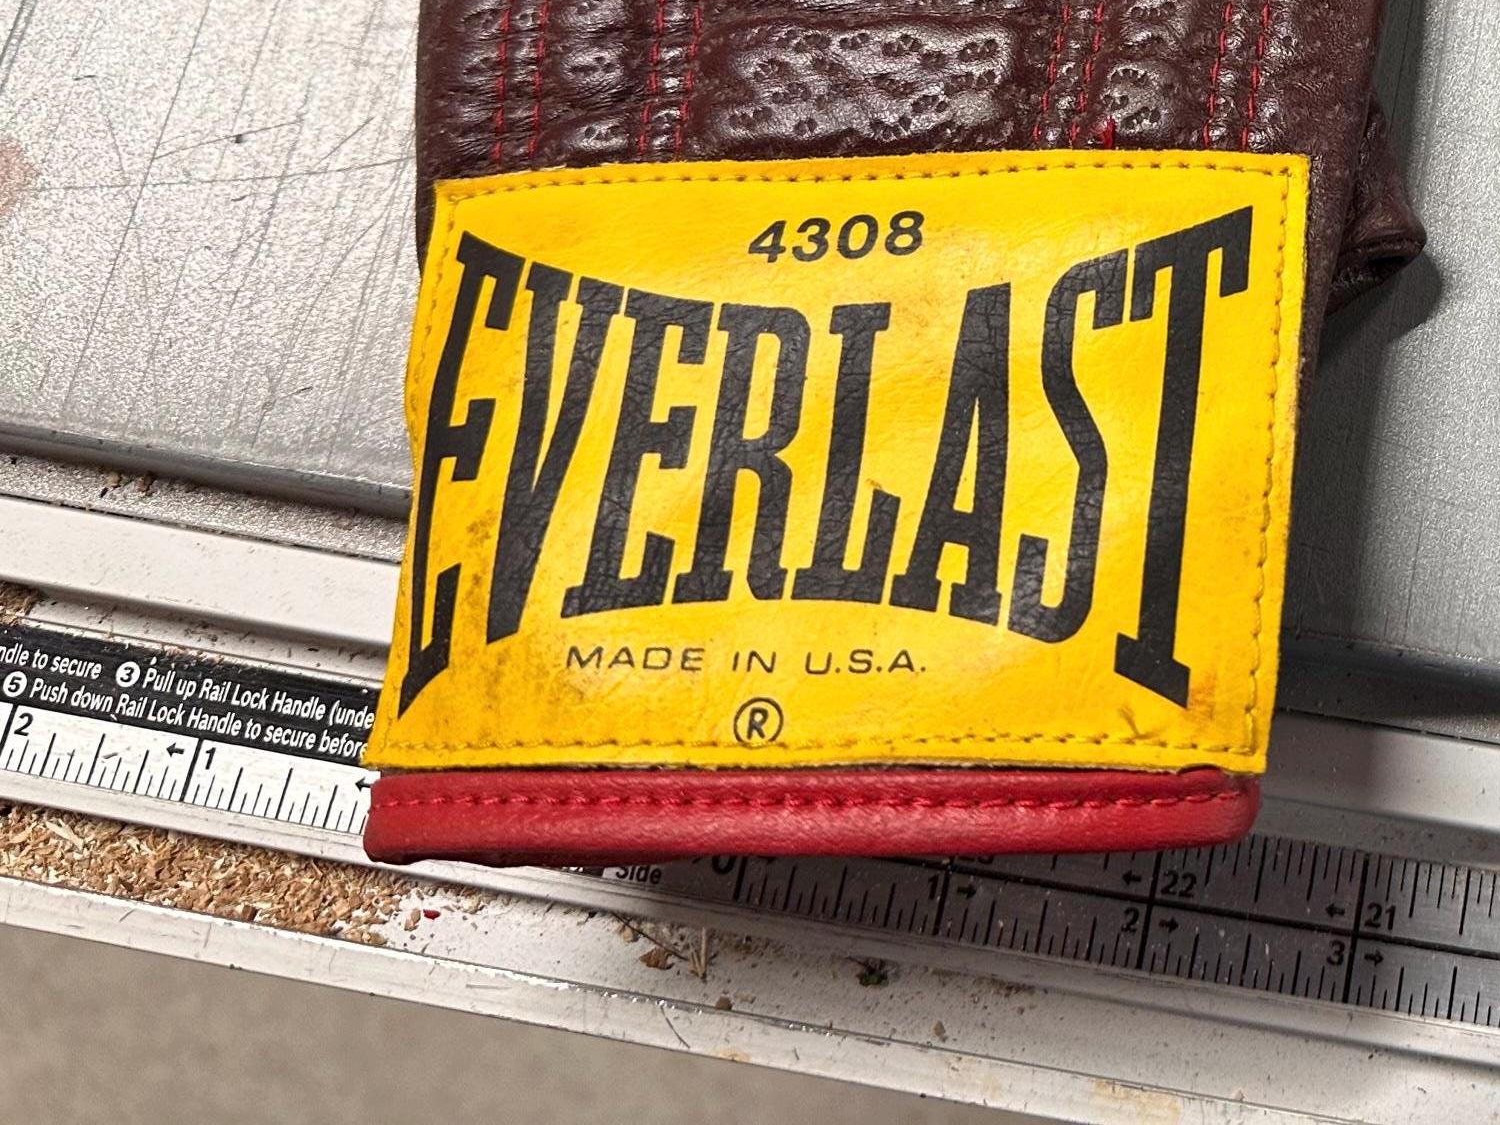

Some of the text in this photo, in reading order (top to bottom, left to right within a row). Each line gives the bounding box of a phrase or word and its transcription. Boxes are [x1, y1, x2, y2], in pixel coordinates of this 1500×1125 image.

[748, 210, 925, 264] 4308
[398, 207, 1253, 708] EVERLAST
[566, 646, 927, 676] MADE IN U.S.A.
[32, 649, 48, 670] to
[50, 655, 102, 680] secure
[142, 668, 176, 693] Pull
[176, 679, 197, 700] up
[199, 678, 232, 703] Rail
[231, 683, 270, 711] Lock
[271, 691, 326, 721] Handle
[13, 712, 34, 737] 2
[29, 678, 69, 704] Push
[70, 685, 114, 713] down
[115, 693, 148, 719] Rail
[147, 699, 186, 726] Lock
[187, 707, 242, 736] Handle
[244, 719, 261, 742] to
[263, 725, 317, 750] secure
[205, 747, 216, 770] 1
[927, 875, 939, 900] 1
[1161, 871, 1197, 898] 22
[1121, 908, 1140, 933] 2
[1366, 902, 1396, 931] 21
[1326, 940, 1345, 966] 3
